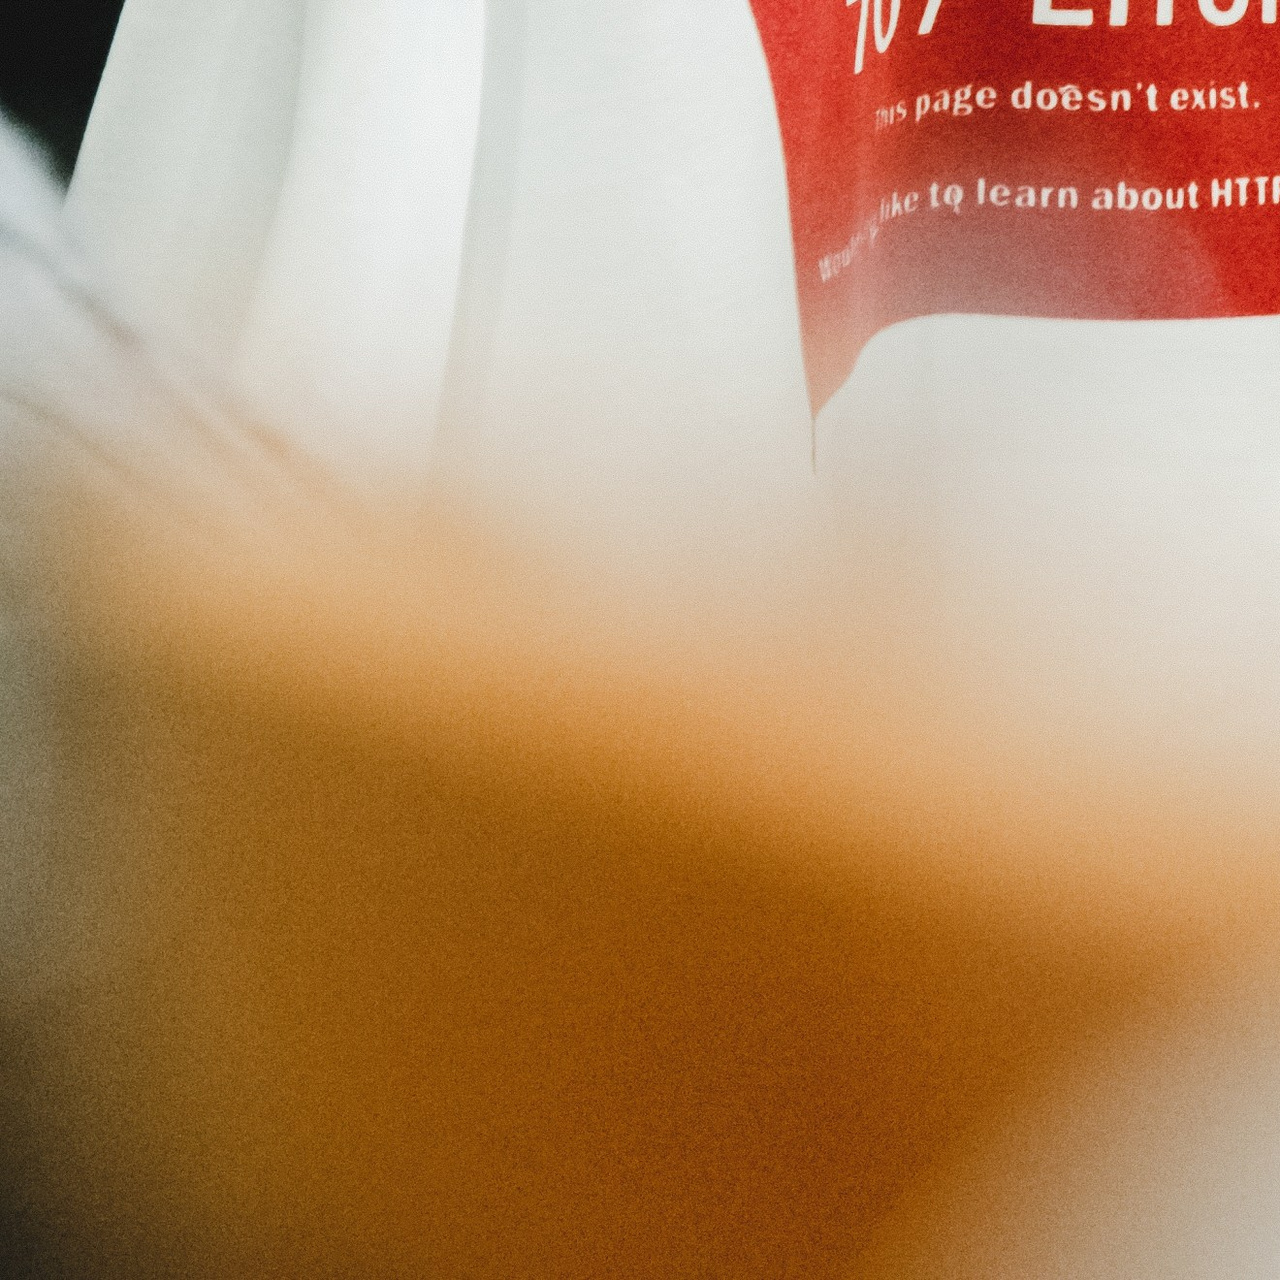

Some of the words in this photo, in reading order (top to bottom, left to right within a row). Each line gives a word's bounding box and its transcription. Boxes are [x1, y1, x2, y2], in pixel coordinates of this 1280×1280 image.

[915, 84, 997, 122] page
[1010, 80, 1158, 111] doesn't
[1169, 81, 1261, 110] exist.
[930, 181, 964, 213] to
[977, 178, 1079, 208] learn
[1091, 180, 1200, 210] about
